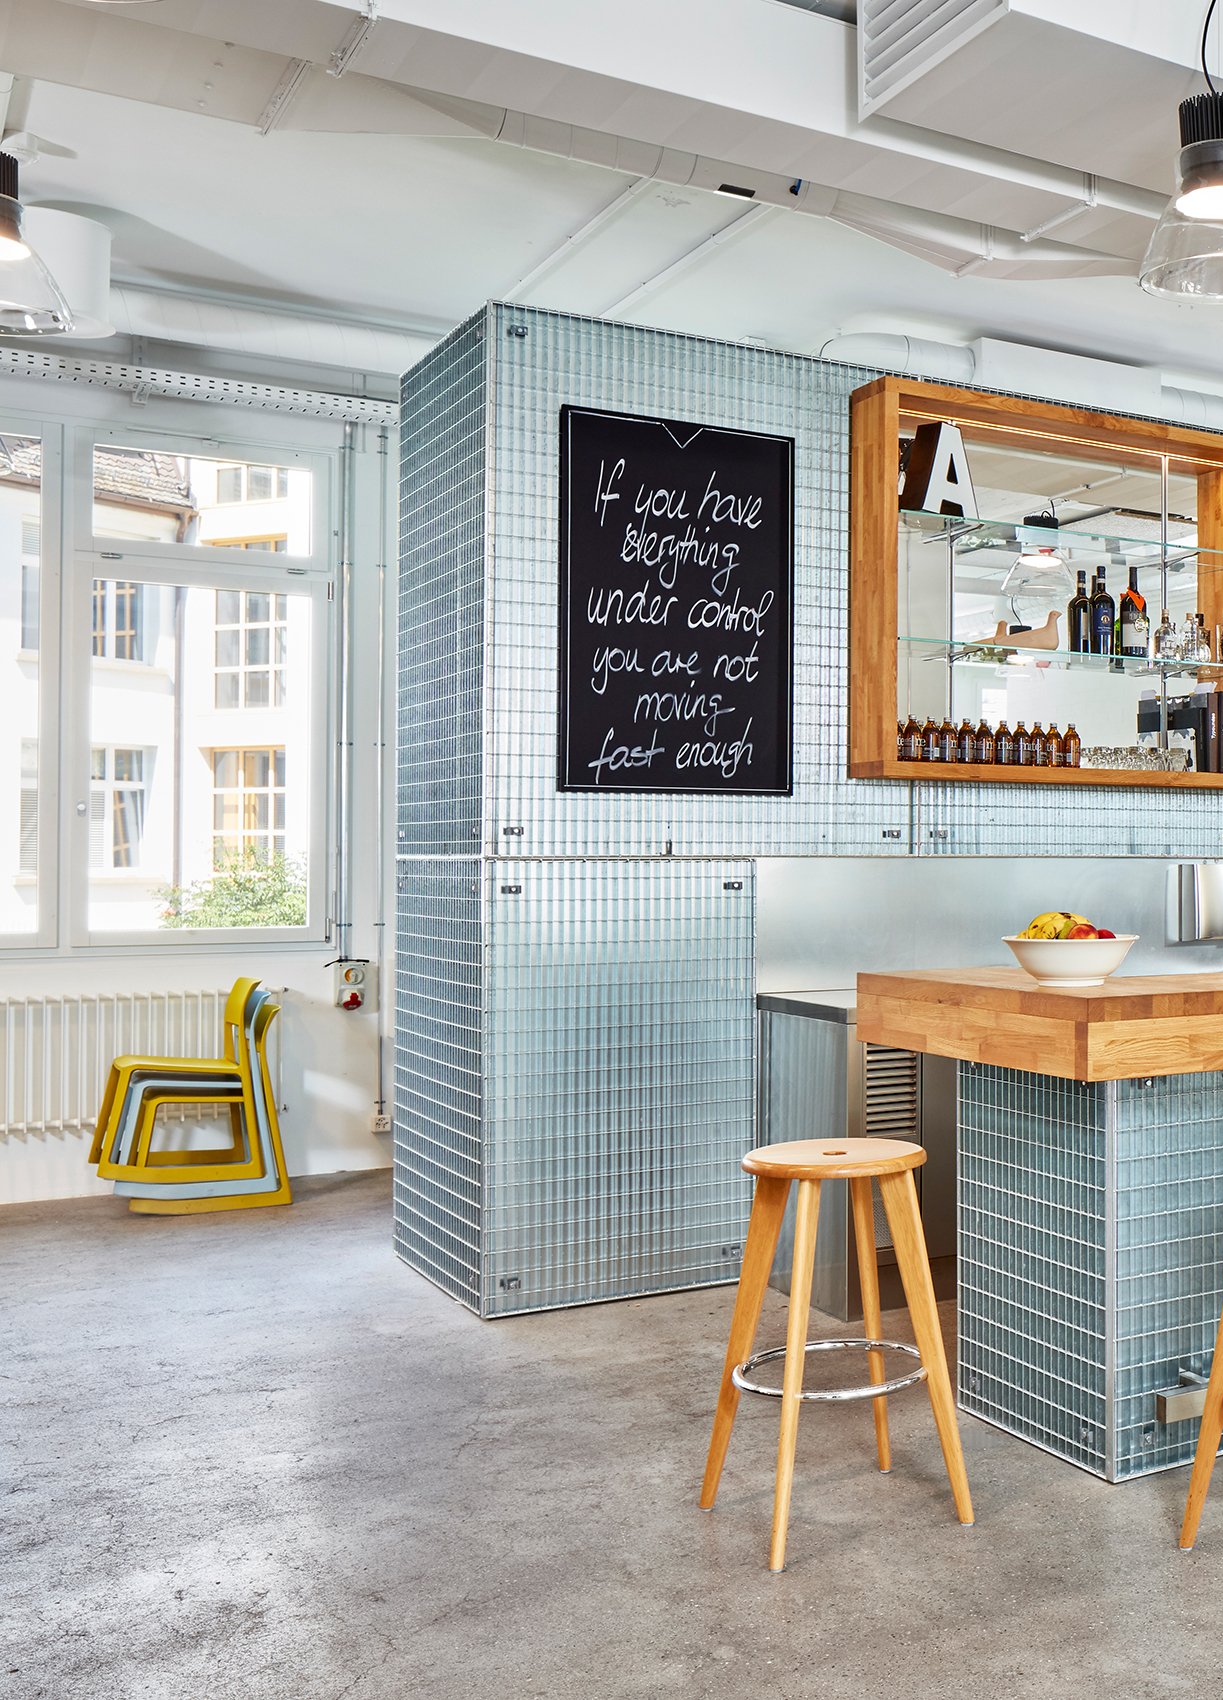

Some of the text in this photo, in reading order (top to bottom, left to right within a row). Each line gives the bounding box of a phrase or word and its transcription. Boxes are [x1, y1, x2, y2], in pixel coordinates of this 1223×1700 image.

[594, 458, 763, 540] If you have
[922, 422, 979, 519] A
[620, 523, 740, 597] everything
[588, 580, 774, 637] under control
[591, 641, 760, 695] you are not
[634, 680, 736, 737] moving
[588, 717, 754, 785] fast enough
